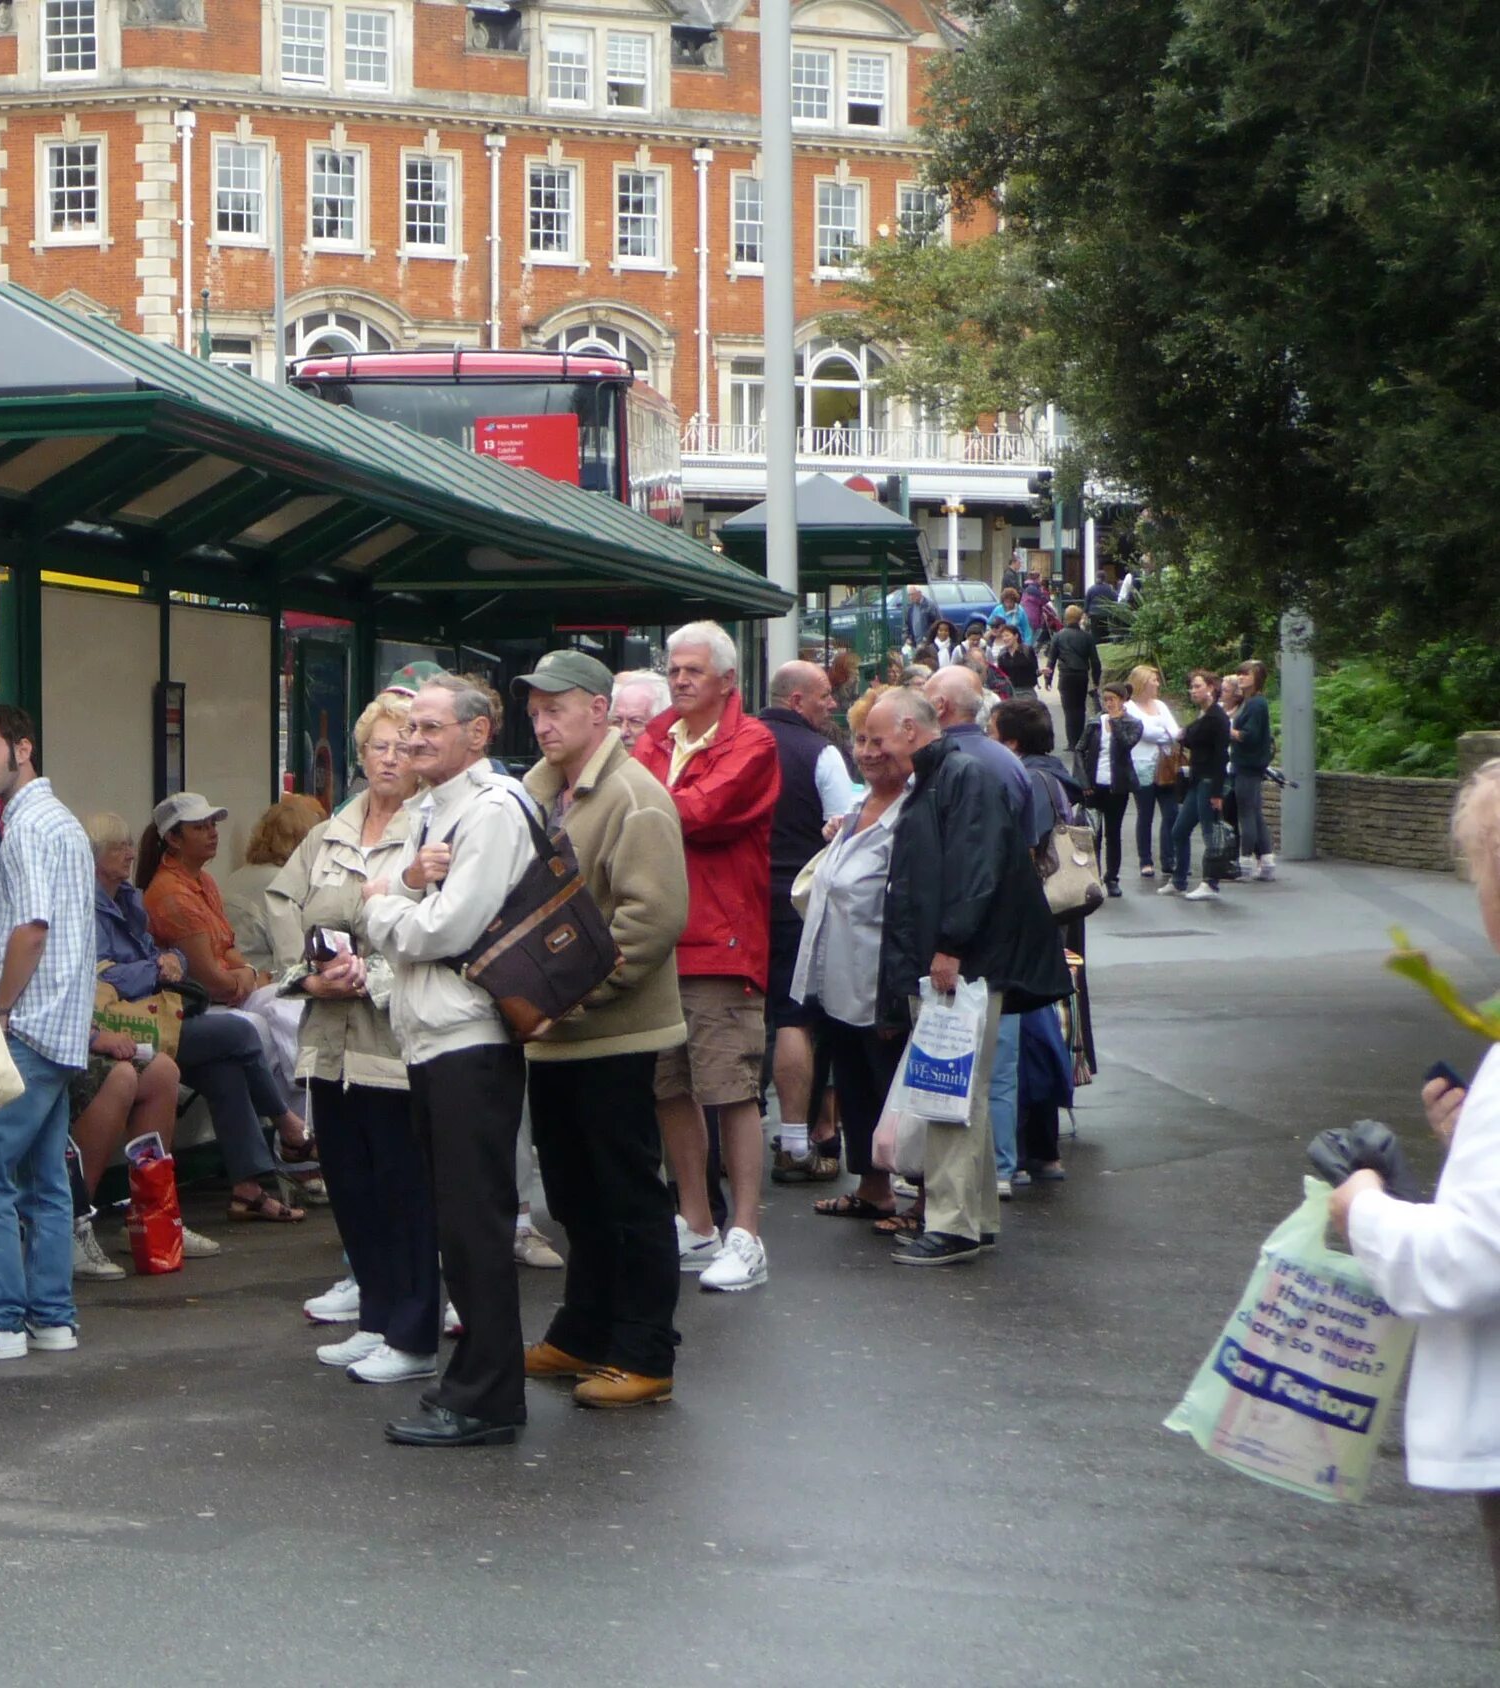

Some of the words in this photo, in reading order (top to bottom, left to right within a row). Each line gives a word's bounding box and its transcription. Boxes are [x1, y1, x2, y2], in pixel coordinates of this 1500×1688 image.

[484, 440, 495, 449] 13
[1289, 1336, 1314, 1354] so
[1319, 1347, 1387, 1378] much?
[1314, 1323, 1377, 1356] others
[1269, 1369, 1373, 1427] Factory
